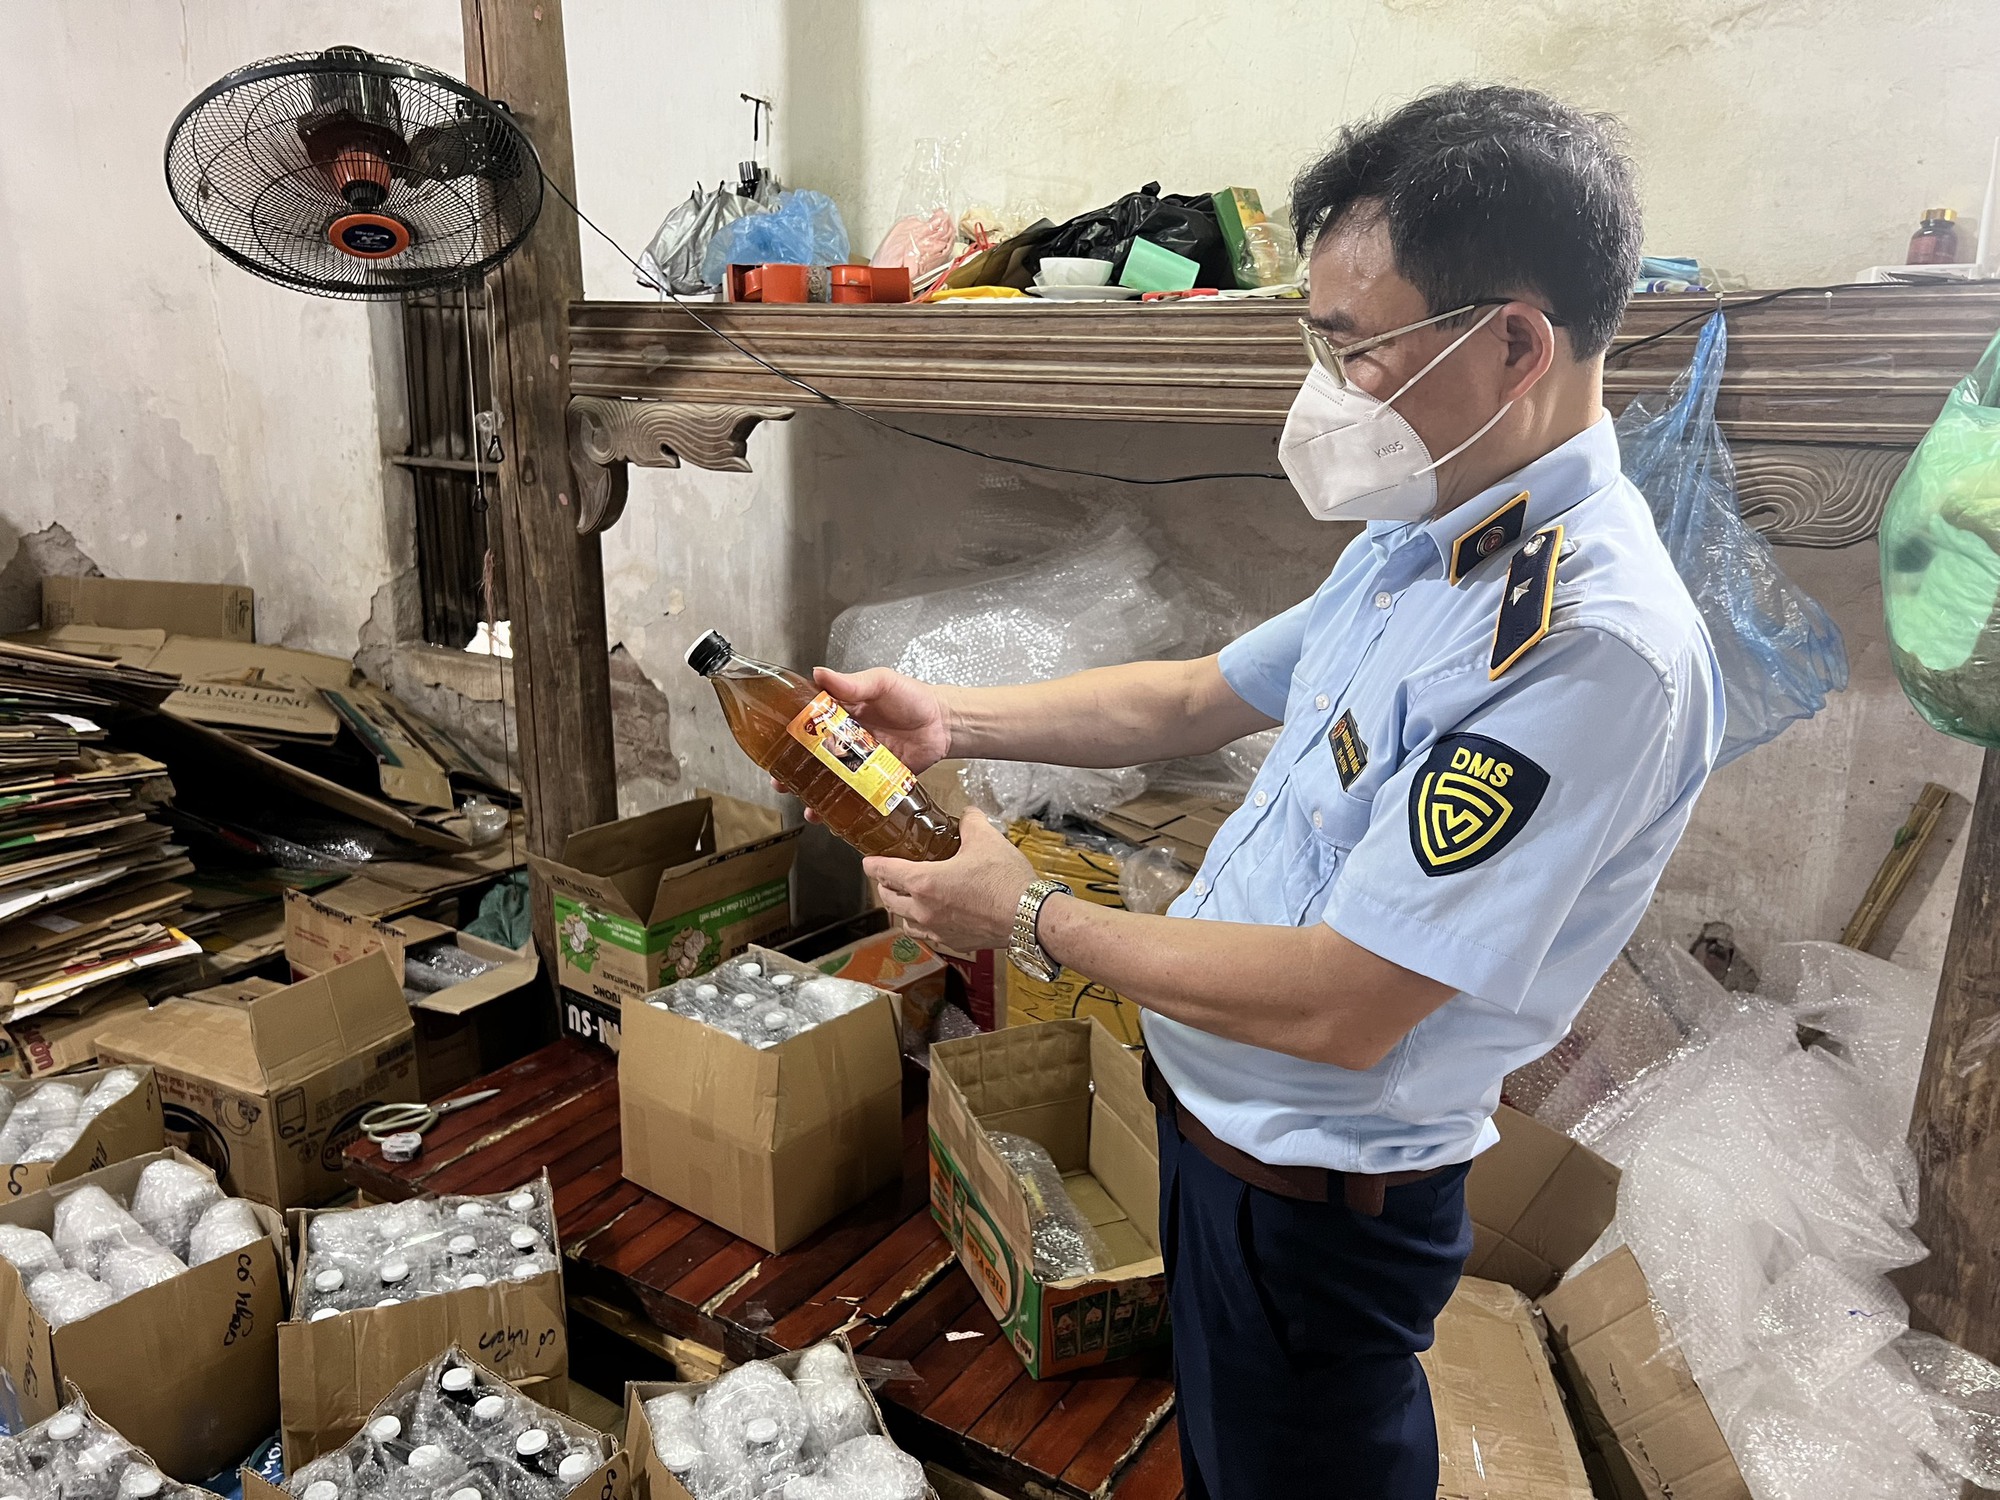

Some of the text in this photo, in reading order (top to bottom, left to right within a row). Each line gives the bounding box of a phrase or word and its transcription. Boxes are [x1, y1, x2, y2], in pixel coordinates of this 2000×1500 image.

[1374, 440, 1404, 458] KN95
[251, 692, 310, 710] LONG
[1450, 746, 1514, 788] DMS
